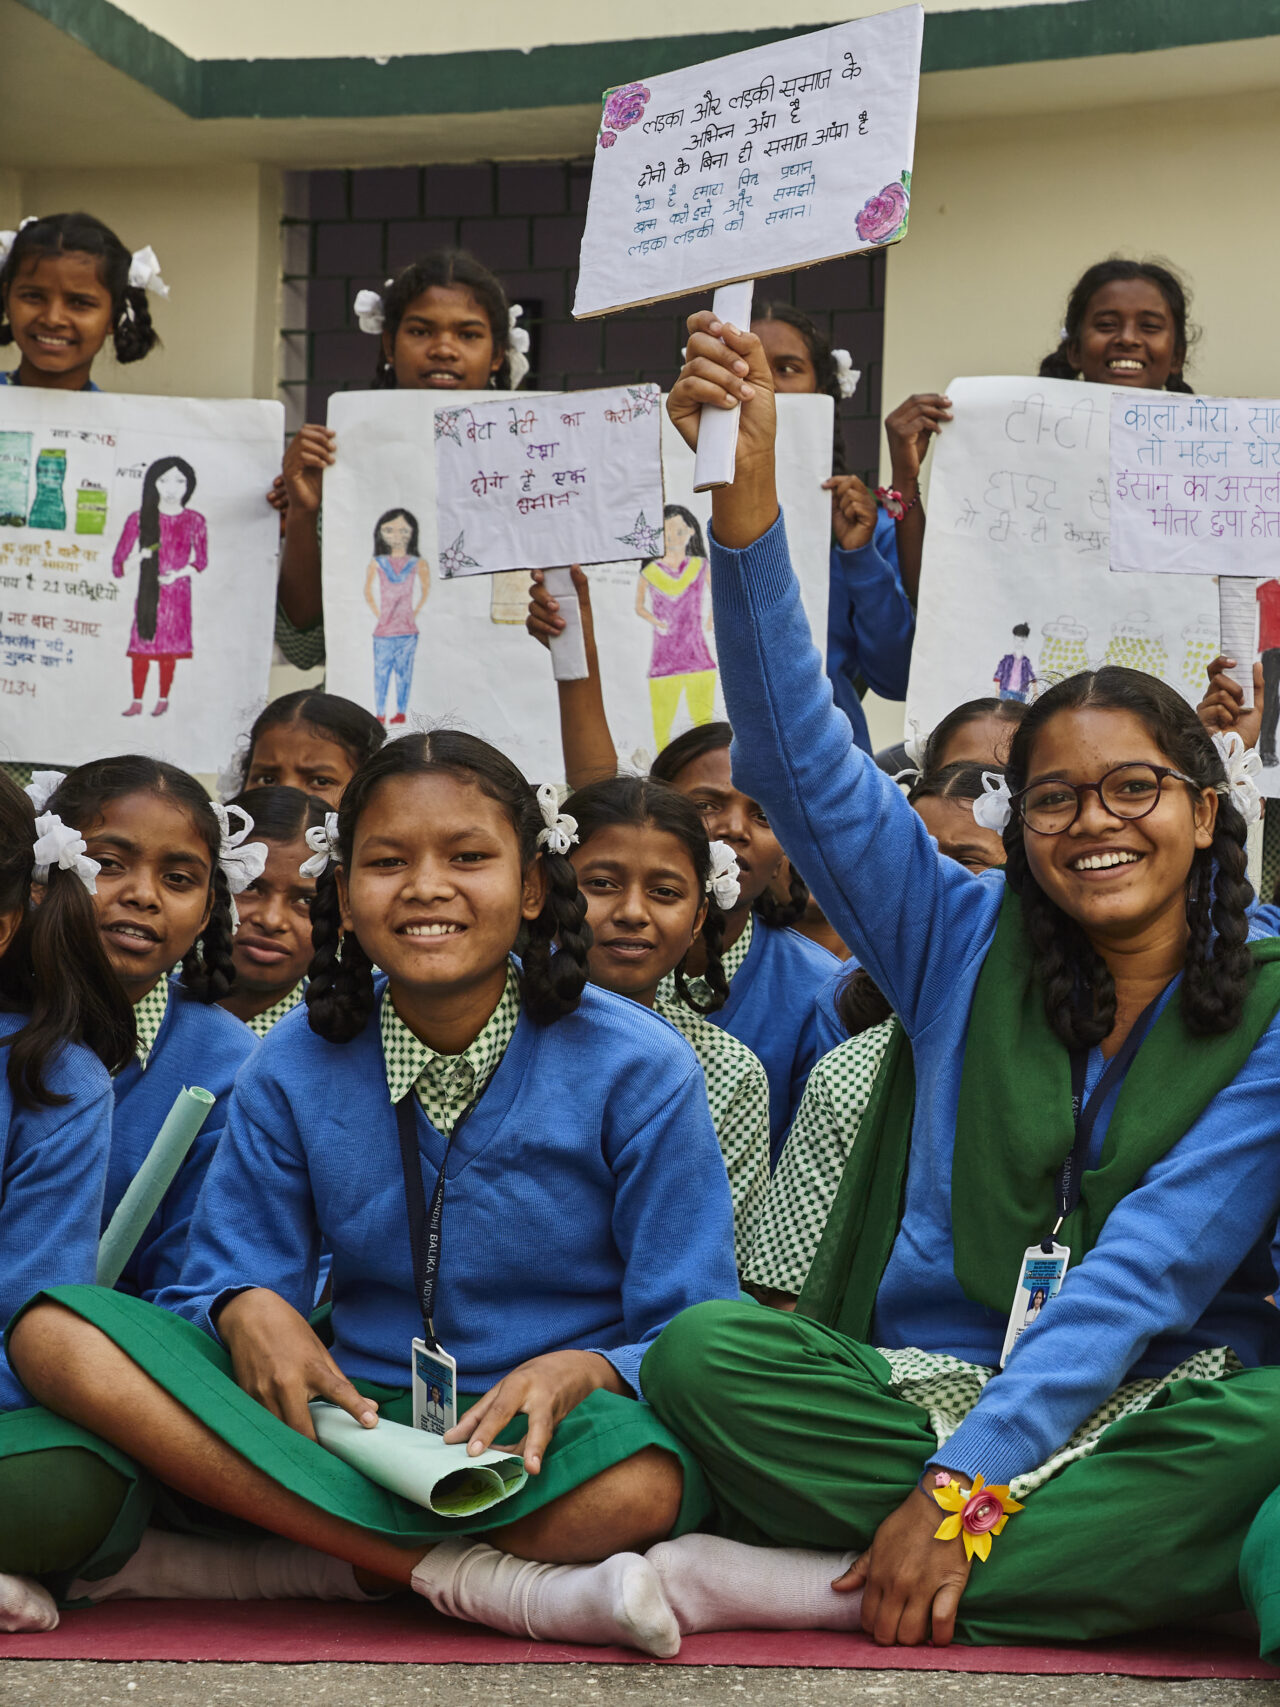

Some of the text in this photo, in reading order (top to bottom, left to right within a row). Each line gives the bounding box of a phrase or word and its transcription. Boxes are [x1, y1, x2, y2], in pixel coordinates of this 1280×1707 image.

[690, 90, 722, 123] और
[729, 75, 775, 108] लड़की
[779, 69, 832, 97] समाज
[842, 52, 861, 80] के
[745, 111, 776, 135] अंग
[790, 98, 800, 123] है
[674, 158, 690, 175] के
[700, 151, 728, 172] बिना
[738, 141, 752, 163] ही
[764, 132, 807, 157] समाज
[858, 110, 868, 135] है
[723, 189, 752, 214] और
[725, 211, 743, 231] को
[465, 409, 496, 443] बेटा
[560, 411, 586, 427] का
[1137, 434, 1166, 466] तो
[1175, 441, 1232, 468] महज
[1116, 470, 1173, 501] इंसान
[1184, 475, 1215, 502] का
[1147, 503, 1202, 537] भीतर
[425, 1233, 438, 1274] BALIKA
